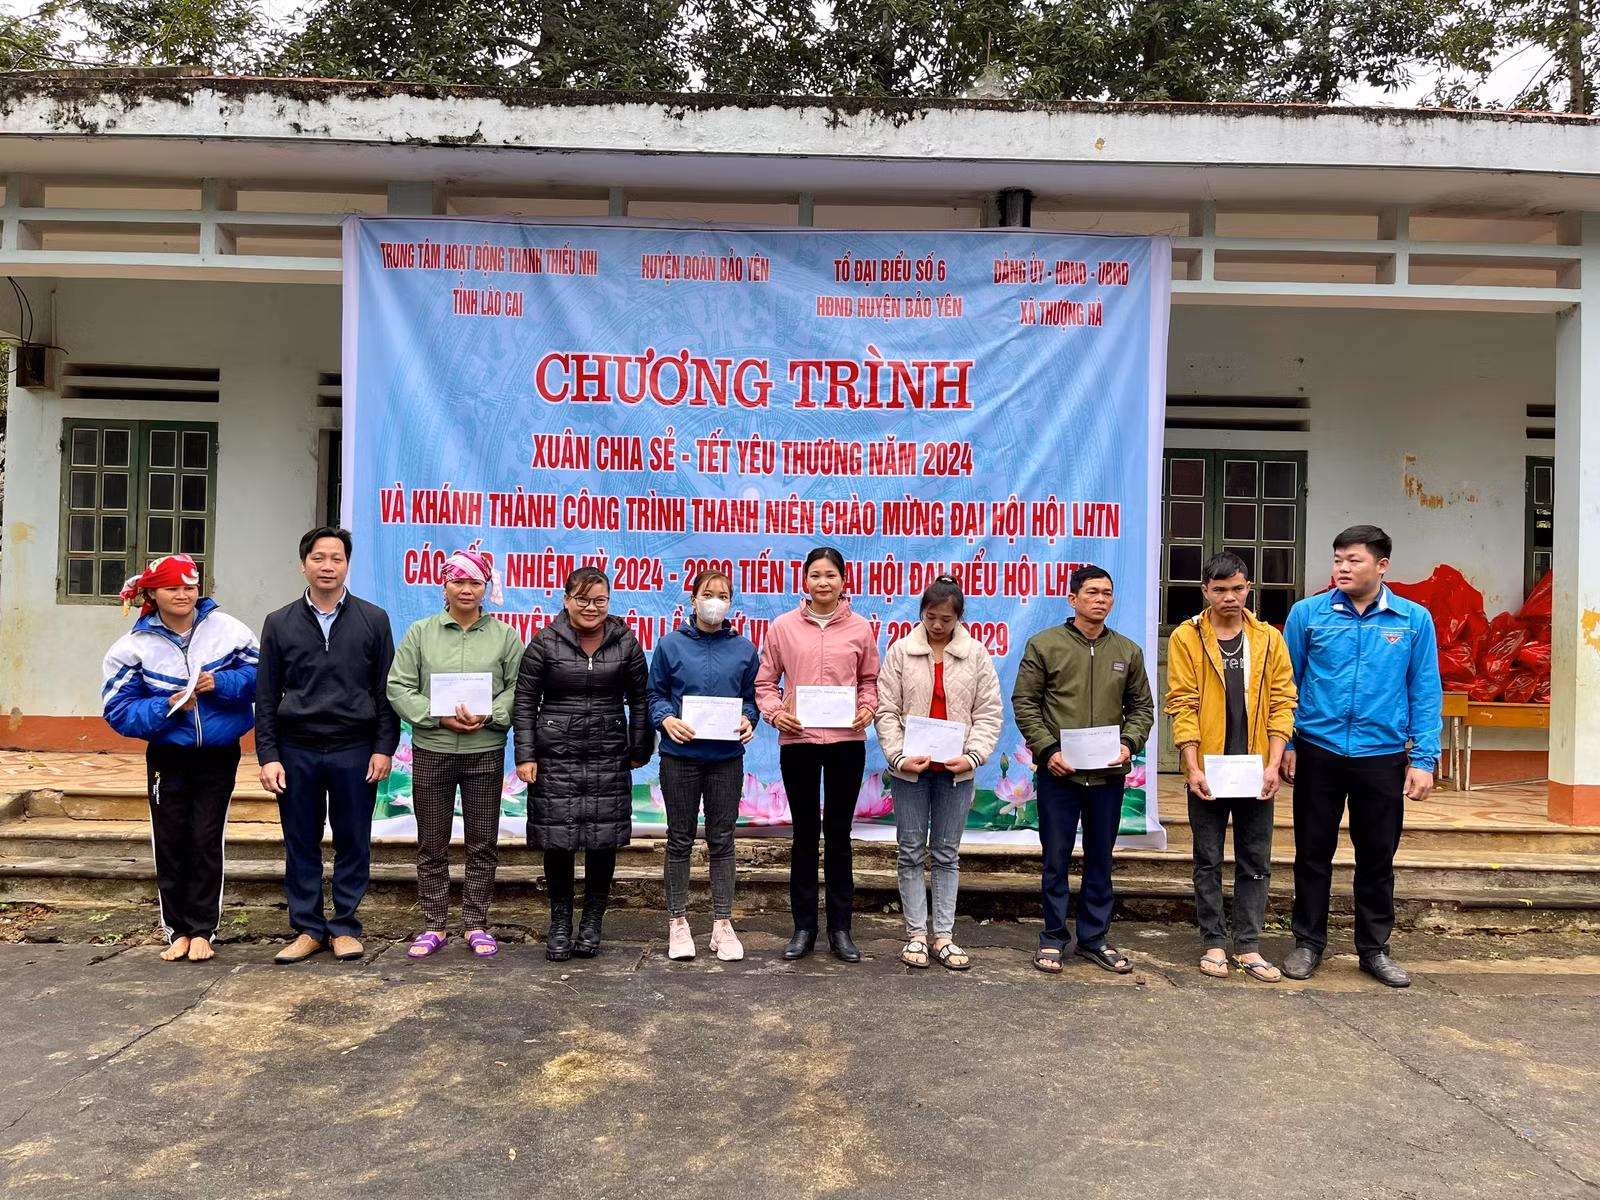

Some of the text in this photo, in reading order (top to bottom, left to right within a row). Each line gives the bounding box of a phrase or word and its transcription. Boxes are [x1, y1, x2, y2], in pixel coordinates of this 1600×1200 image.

[380, 237, 598, 277] TRUNG TÂM HOẠT ĐỘNG THANH THIẾU NHI
[641, 246, 770, 286] HUYỆN ĐOÀN BẢO YÊN
[833, 250, 946, 287] TỔ ĐẠI BIỂU SỐ 6
[993, 251, 1027, 284] ĐẢNG
[1029, 251, 1045, 284] ỦY
[1055, 260, 1087, 286] HĐND
[1097, 260, 1130, 287] UBND
[452, 280, 524, 318] TỈNH LÀO CAI
[816, 289, 963, 323] HĐND HUYỆN BẢO YÊN
[1019, 296, 1103, 332] XÃ THƯỢNG HÀ
[534, 343, 976, 412] CHƯƠNG TRÌNH
[530, 428, 590, 472] XUÂN
[595, 434, 644, 472] CHIA
[648, 425, 677, 473] SẺ
[695, 428, 732, 475] TẾT
[736, 430, 776, 476] YÊU
[780, 436, 863, 478] THƯƠNG
[867, 433, 918, 478] NĂM
[921, 440, 974, 478] 2024
[379, 480, 1121, 546] VÀ KHÁNH THÀNH CÔNG TRÌNH THANH NIÊN CHÀO MỪNG ĐẠI HỘI HỘI LHTN
[404, 542, 447, 585] CÁC
[613, 556, 664, 593] 2024
[738, 548, 784, 594] TIẾN
[868, 554, 904, 604] HỘI
[1003, 554, 1040, 605] HỘI
